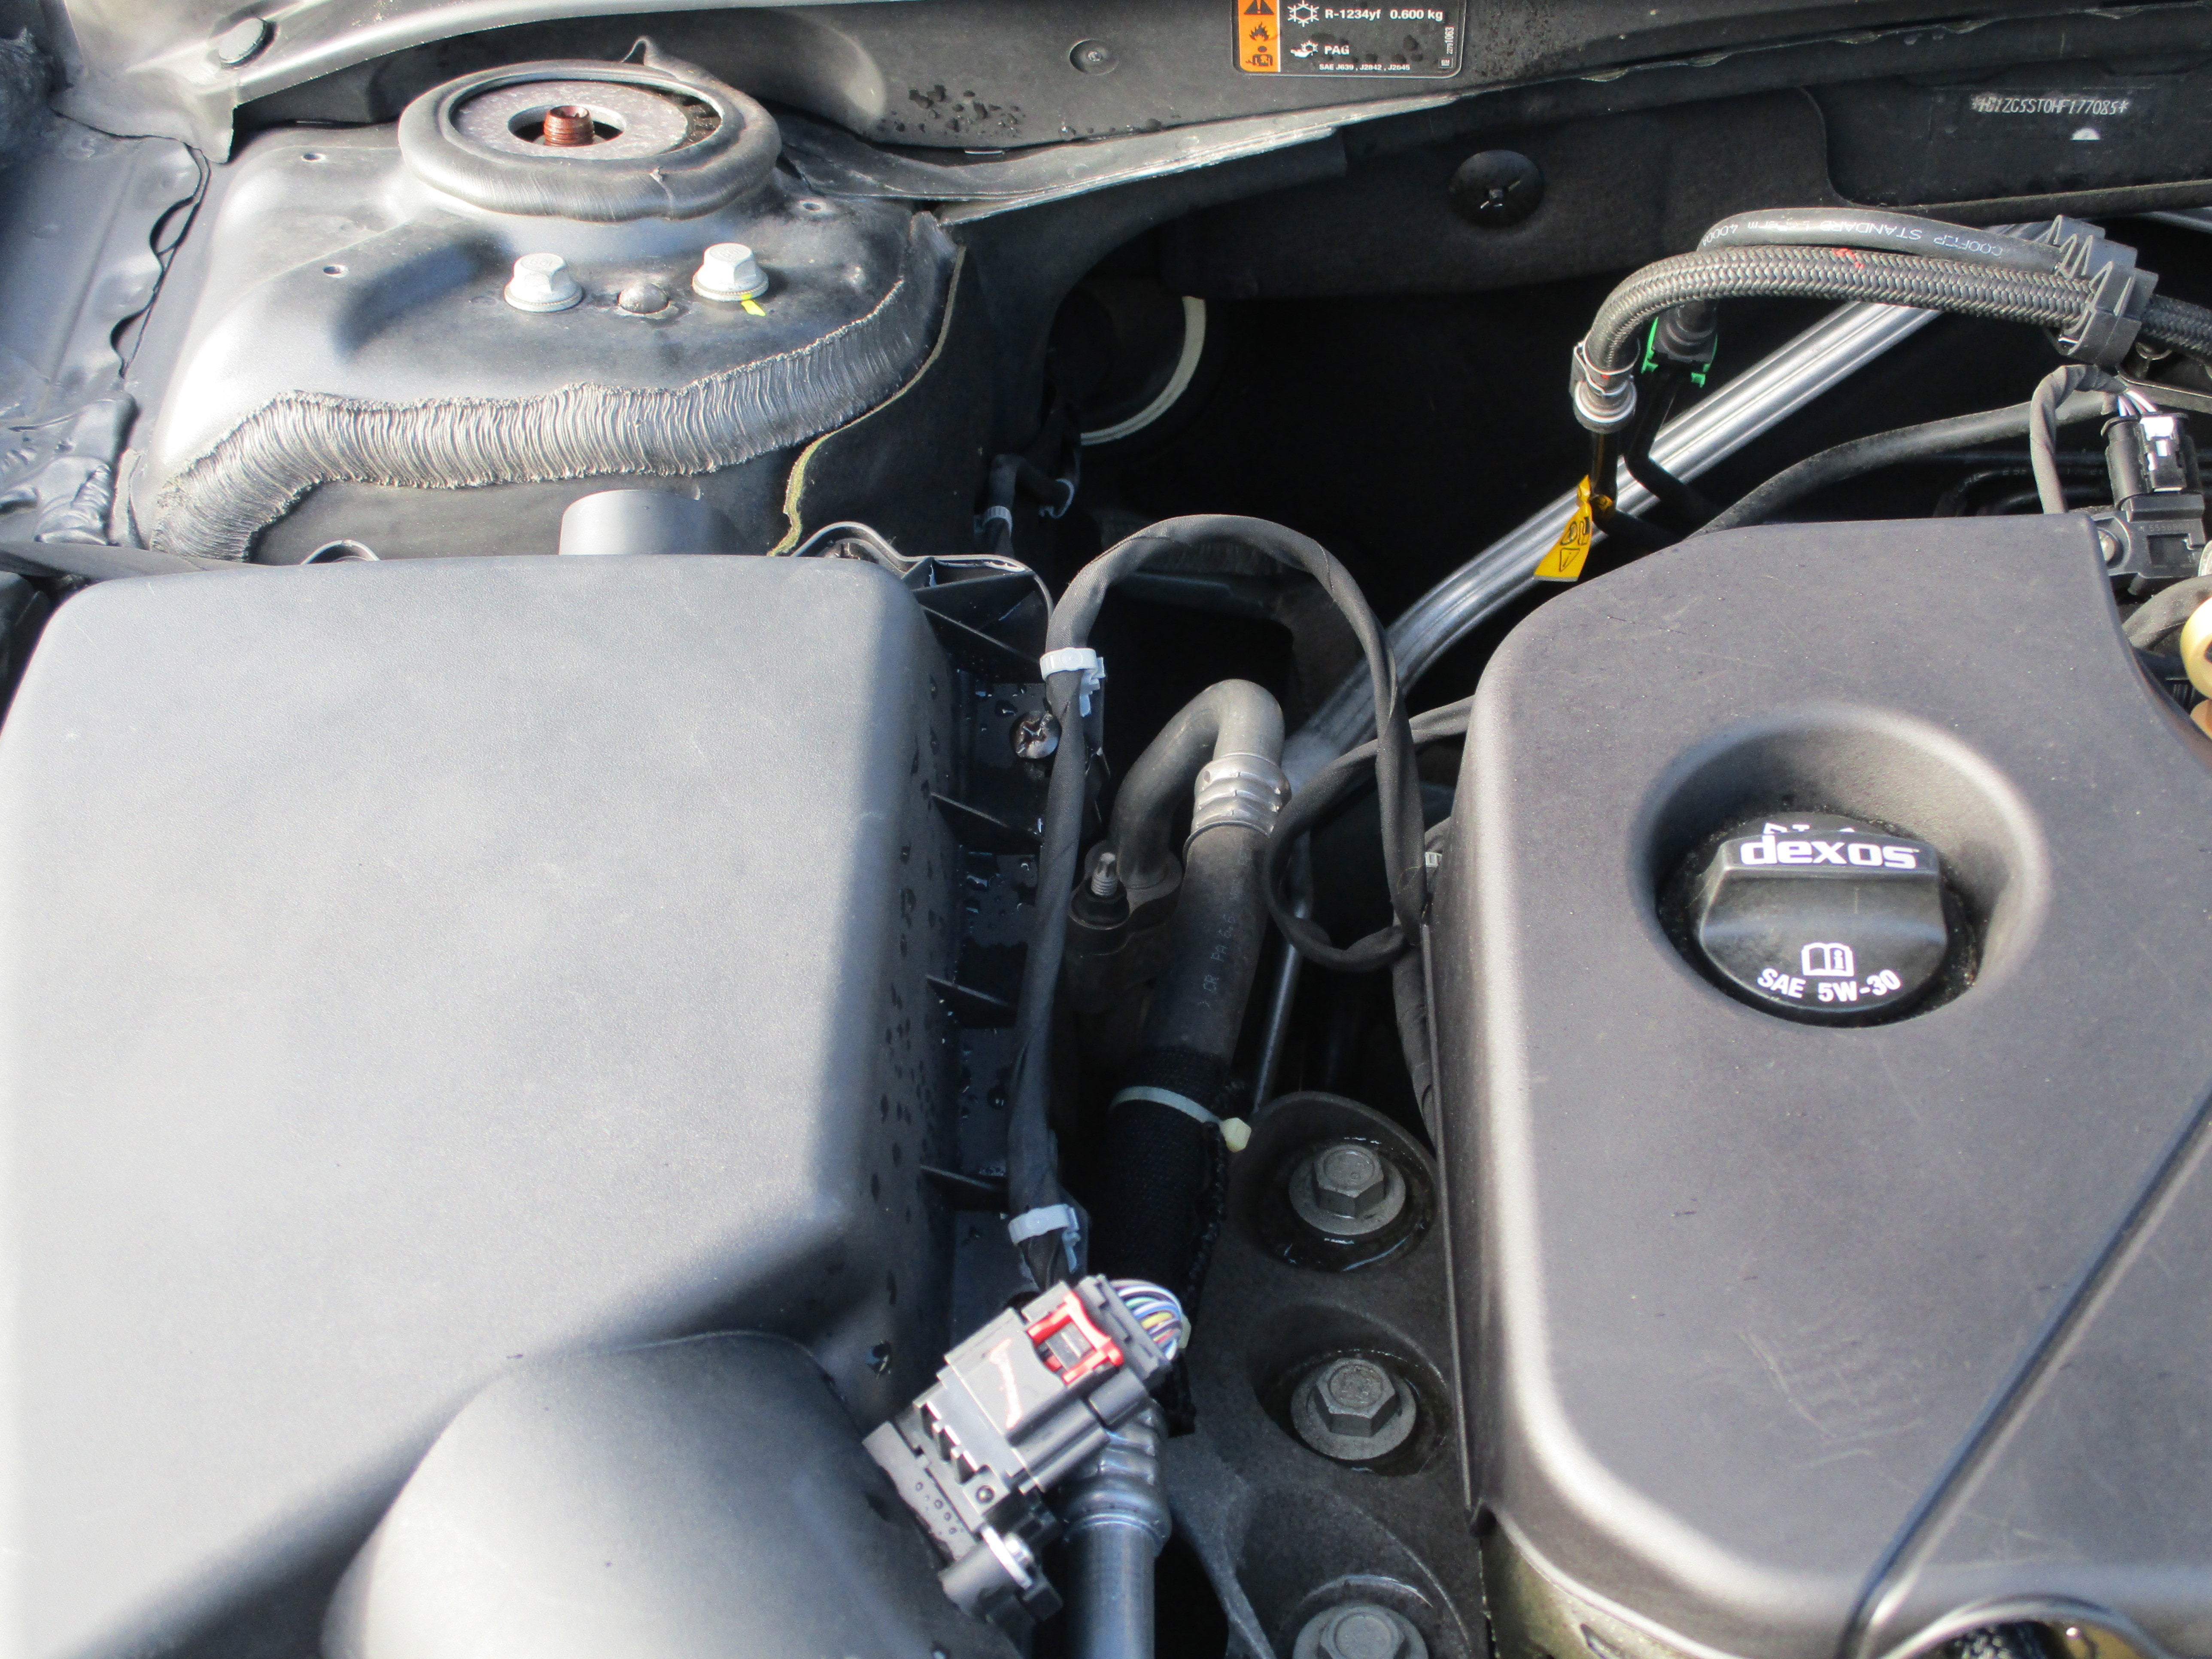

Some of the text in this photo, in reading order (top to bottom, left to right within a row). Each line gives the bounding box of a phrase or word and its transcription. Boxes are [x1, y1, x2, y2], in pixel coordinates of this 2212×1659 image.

[1325, 9, 1443, 21] R-1234yf 0.600 kg
[1325, 45, 1349, 55] PAG
[1740, 835, 1917, 869] dexos
[1757, 968, 1902, 1002] SAE 5W-30
